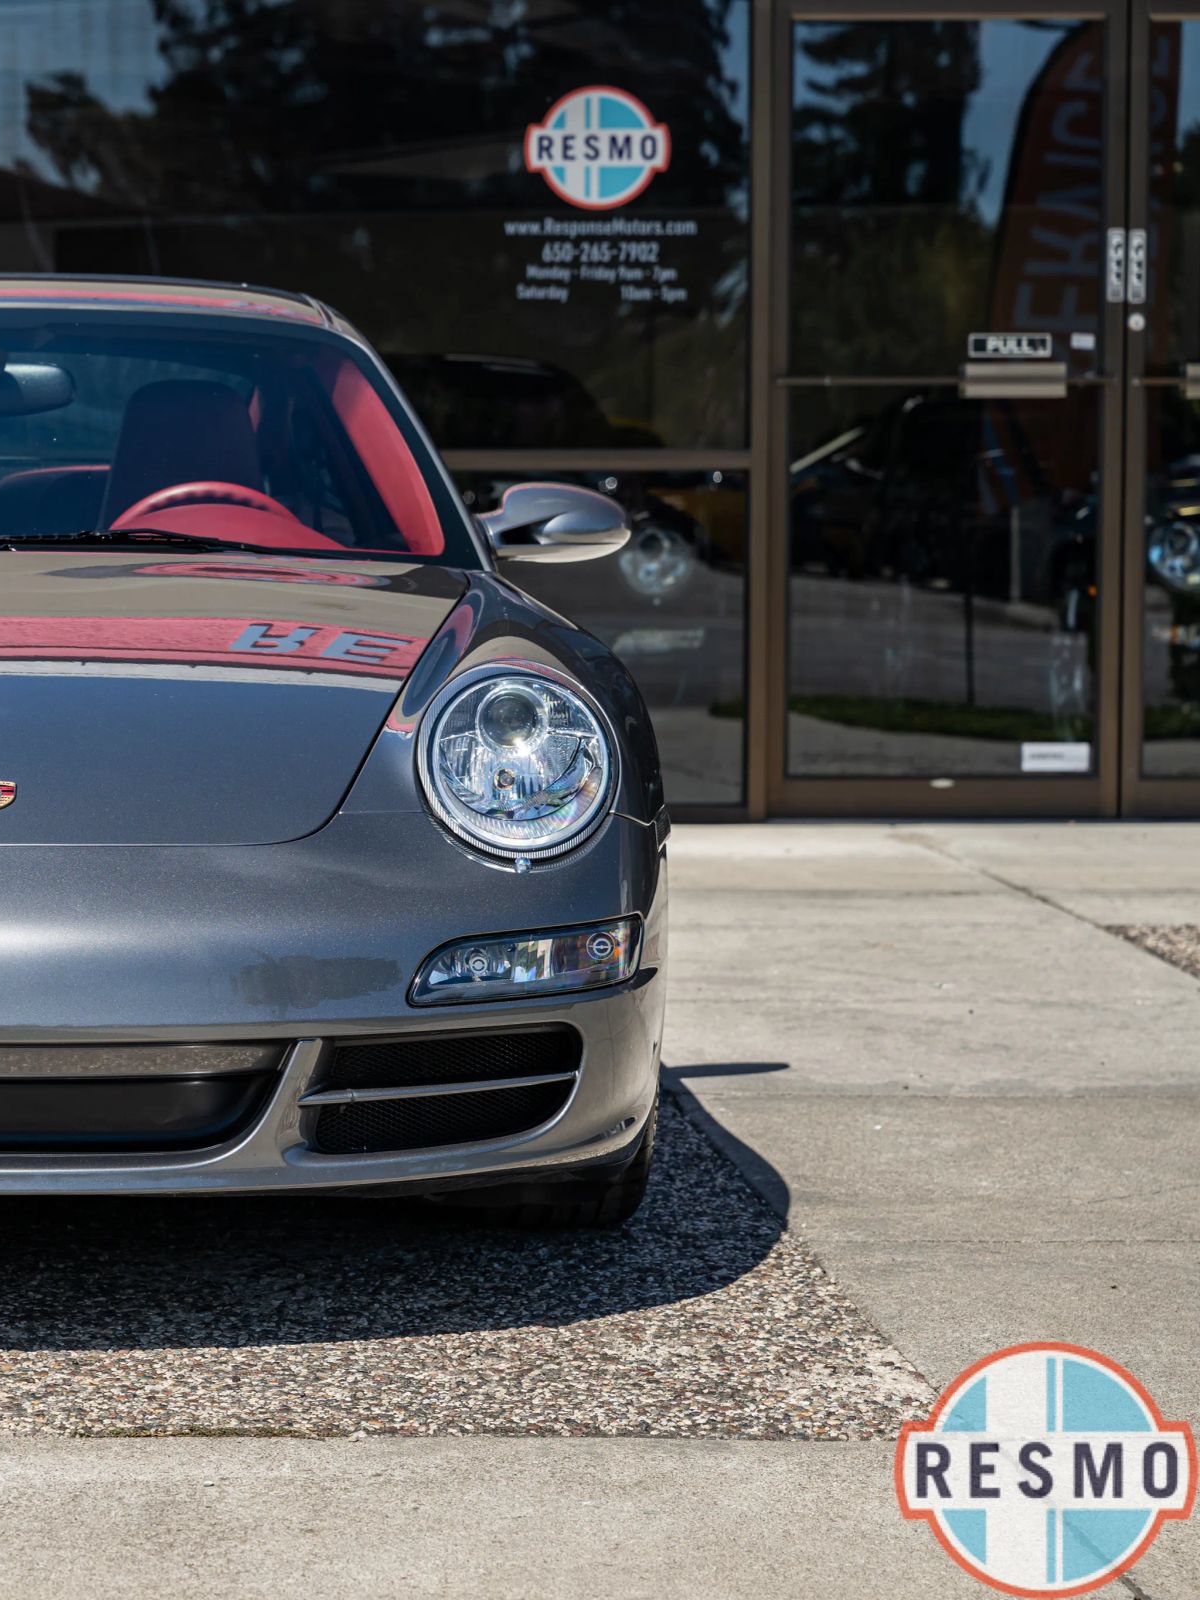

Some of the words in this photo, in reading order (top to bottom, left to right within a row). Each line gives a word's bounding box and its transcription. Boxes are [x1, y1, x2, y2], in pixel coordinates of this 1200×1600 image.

[537, 135, 657, 161] RESMO
[504, 217, 697, 239] www.ResponseMotors.com
[542, 241, 659, 263] 650-265-7902
[526, 264, 571, 283] Monday
[580, 264, 616, 283] Friday
[516, 283, 569, 304] Saturday
[986, 335, 1033, 355] PULL
